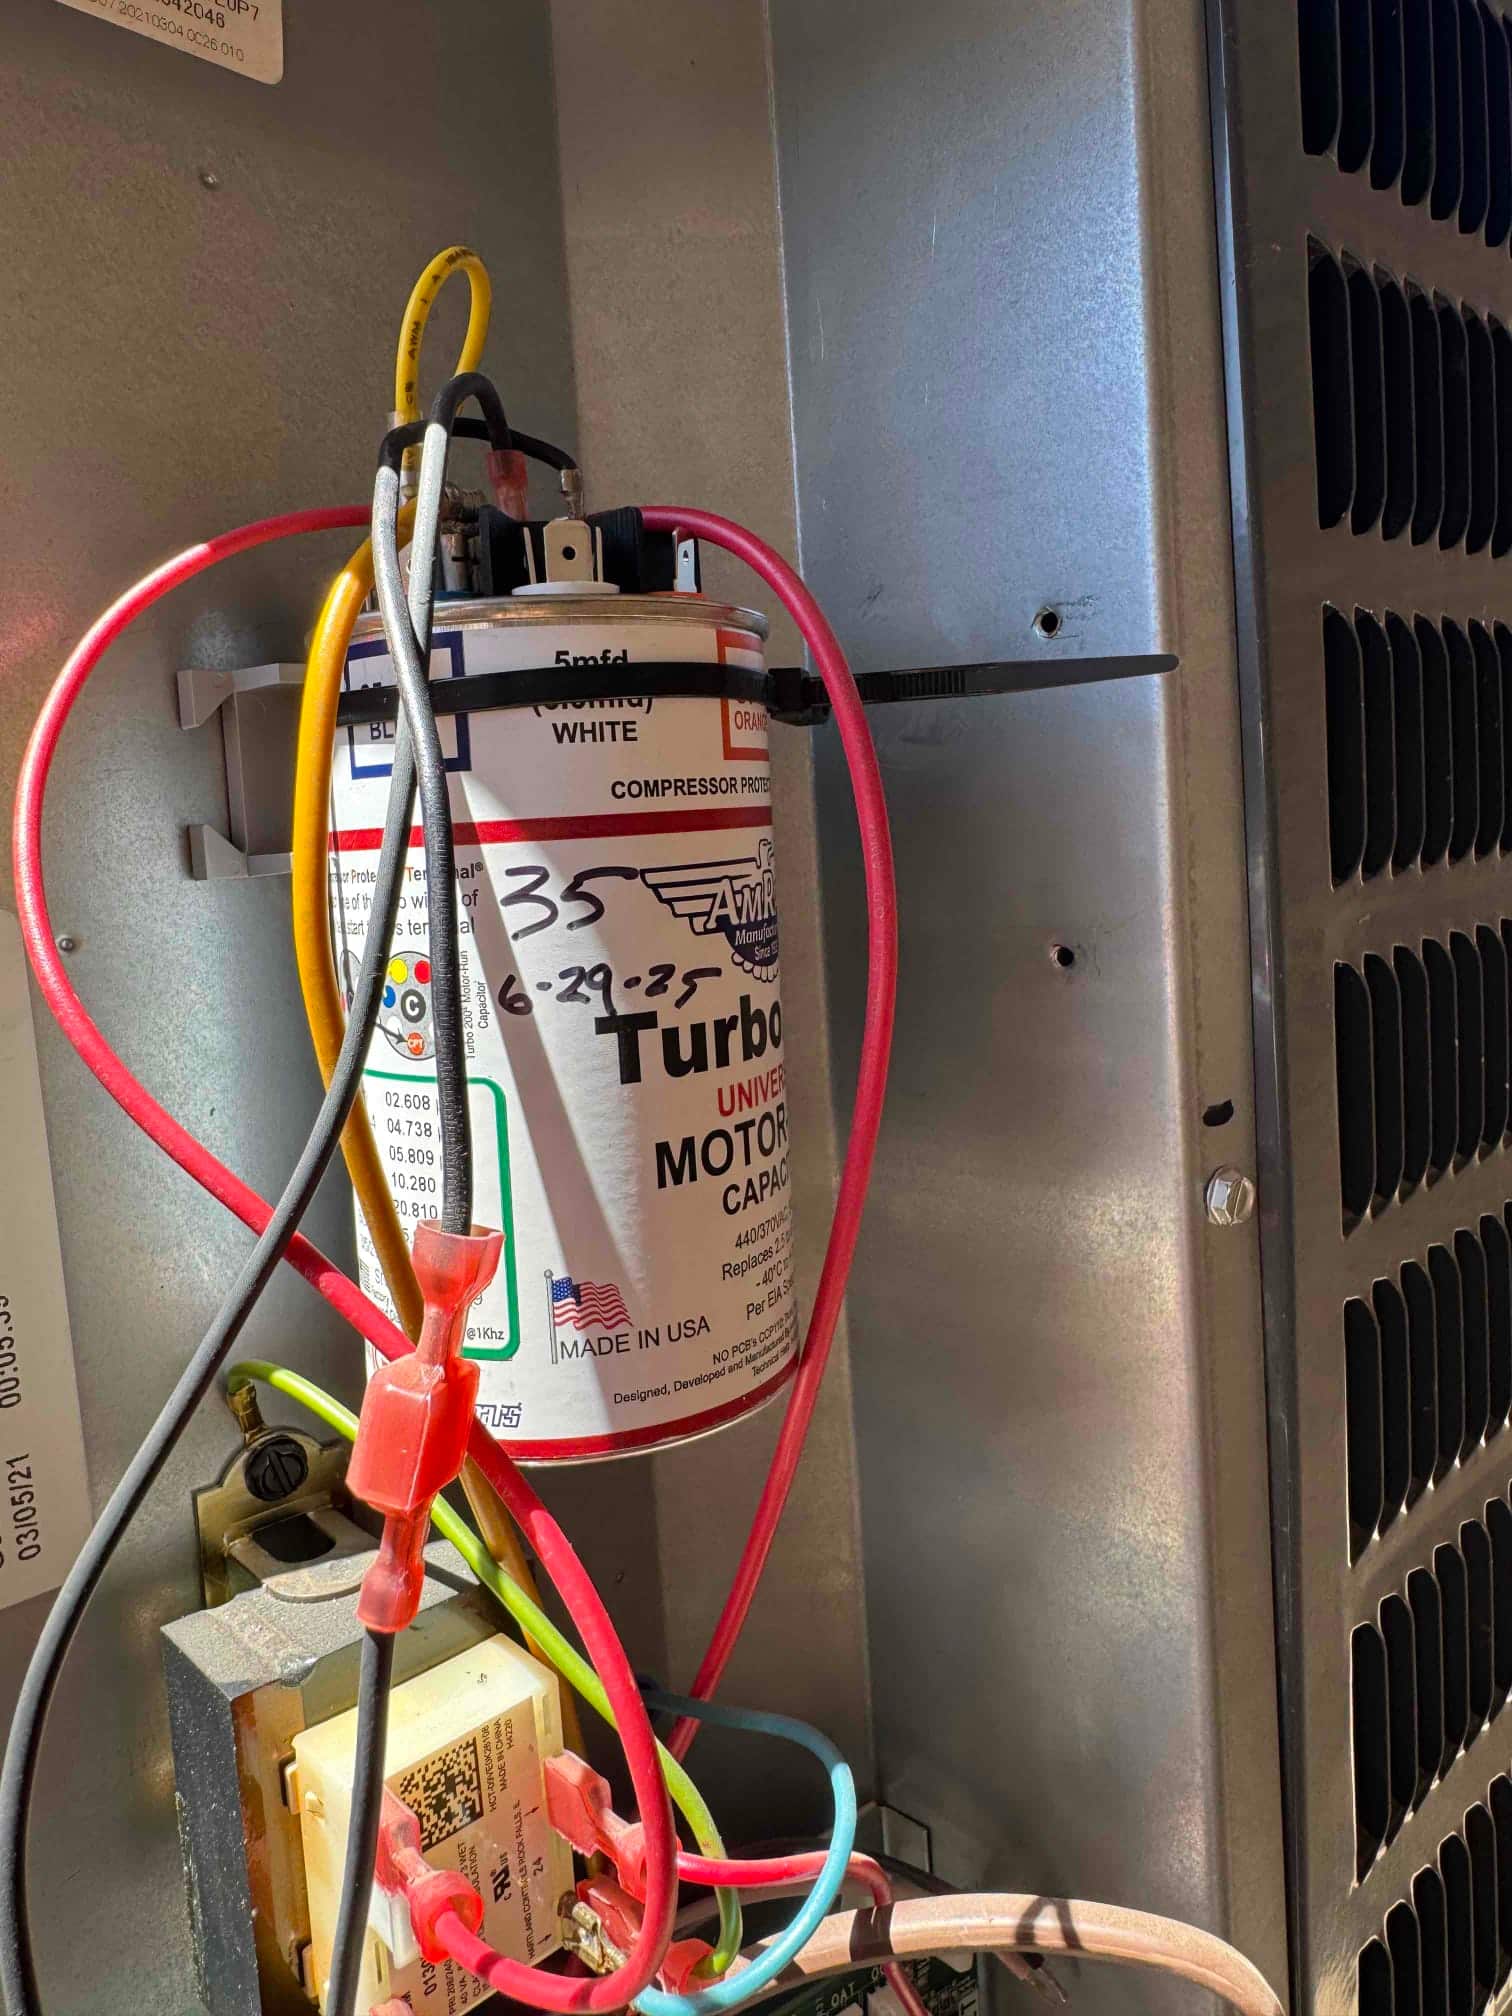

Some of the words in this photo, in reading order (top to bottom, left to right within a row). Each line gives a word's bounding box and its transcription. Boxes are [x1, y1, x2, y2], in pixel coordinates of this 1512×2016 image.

[551, 720, 638, 744] WHITE
[611, 777, 738, 799] COMPRESSOR
[461, 888, 480, 907] of
[500, 865, 639, 941] 35
[498, 962, 723, 1017] 6-29-25
[594, 994, 783, 1085] Turbo
[385, 1091, 430, 1110] 02.608
[387, 1117, 433, 1138] 04.738
[389, 1145, 434, 1166] 05.809
[391, 1171, 436, 1193] 10.280
[722, 1246, 773, 1281] Replaces
[746, 1300, 765, 1320] Per
[767, 1285, 783, 1308] EIA
[560, 1333, 631, 1360] MADE
[638, 1329, 660, 1349] IN
[667, 1315, 711, 1343] USA
[713, 1349, 730, 1365] NO
[732, 1338, 758, 1359] PCB's
[614, 1384, 671, 1404] Designed,
[673, 1366, 726, 1392] Developed
[728, 1360, 743, 1374] and
[6, 1453, 42, 1562] 03/05/21
